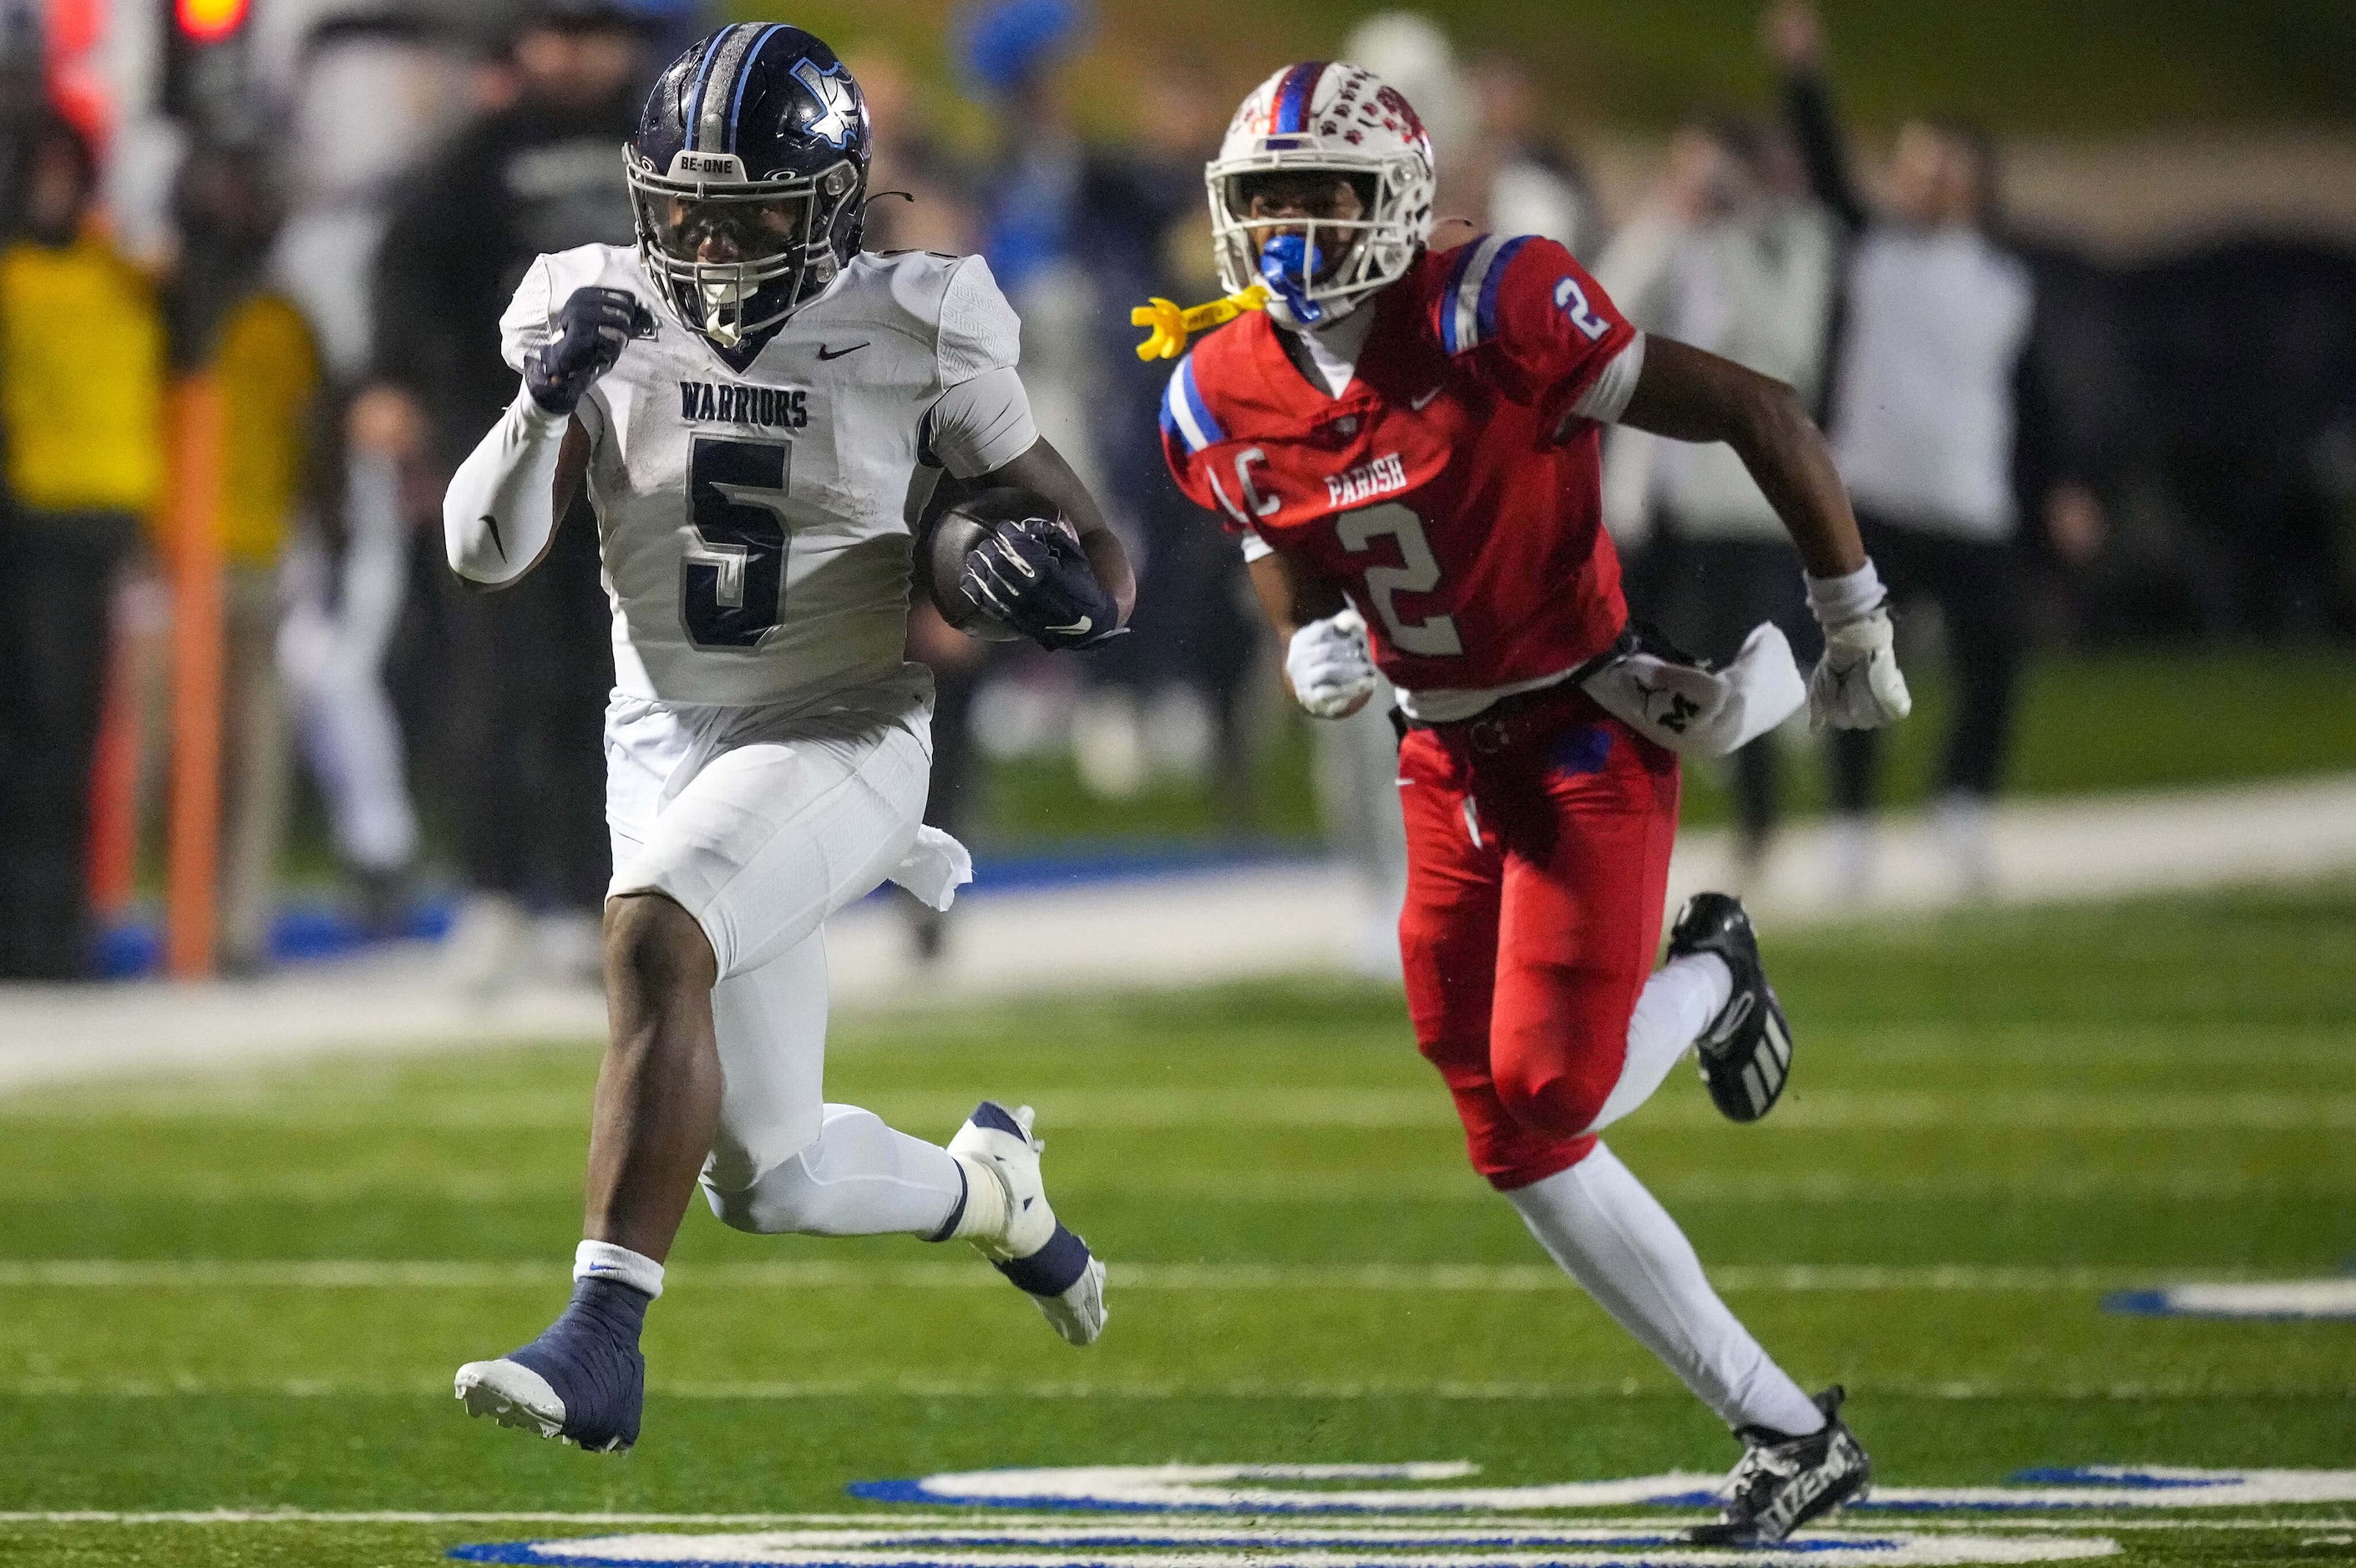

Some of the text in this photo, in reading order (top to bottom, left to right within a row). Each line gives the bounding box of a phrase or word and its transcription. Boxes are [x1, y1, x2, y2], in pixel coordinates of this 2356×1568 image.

[681, 157, 732, 174] BE-ONE
[1553, 276, 1612, 341] 2
[680, 382, 808, 427] WARRIORS
[1235, 447, 1280, 517] C
[1324, 453, 1406, 508] PARISH
[679, 432, 792, 651] 5
[1337, 503, 1463, 655] 2
